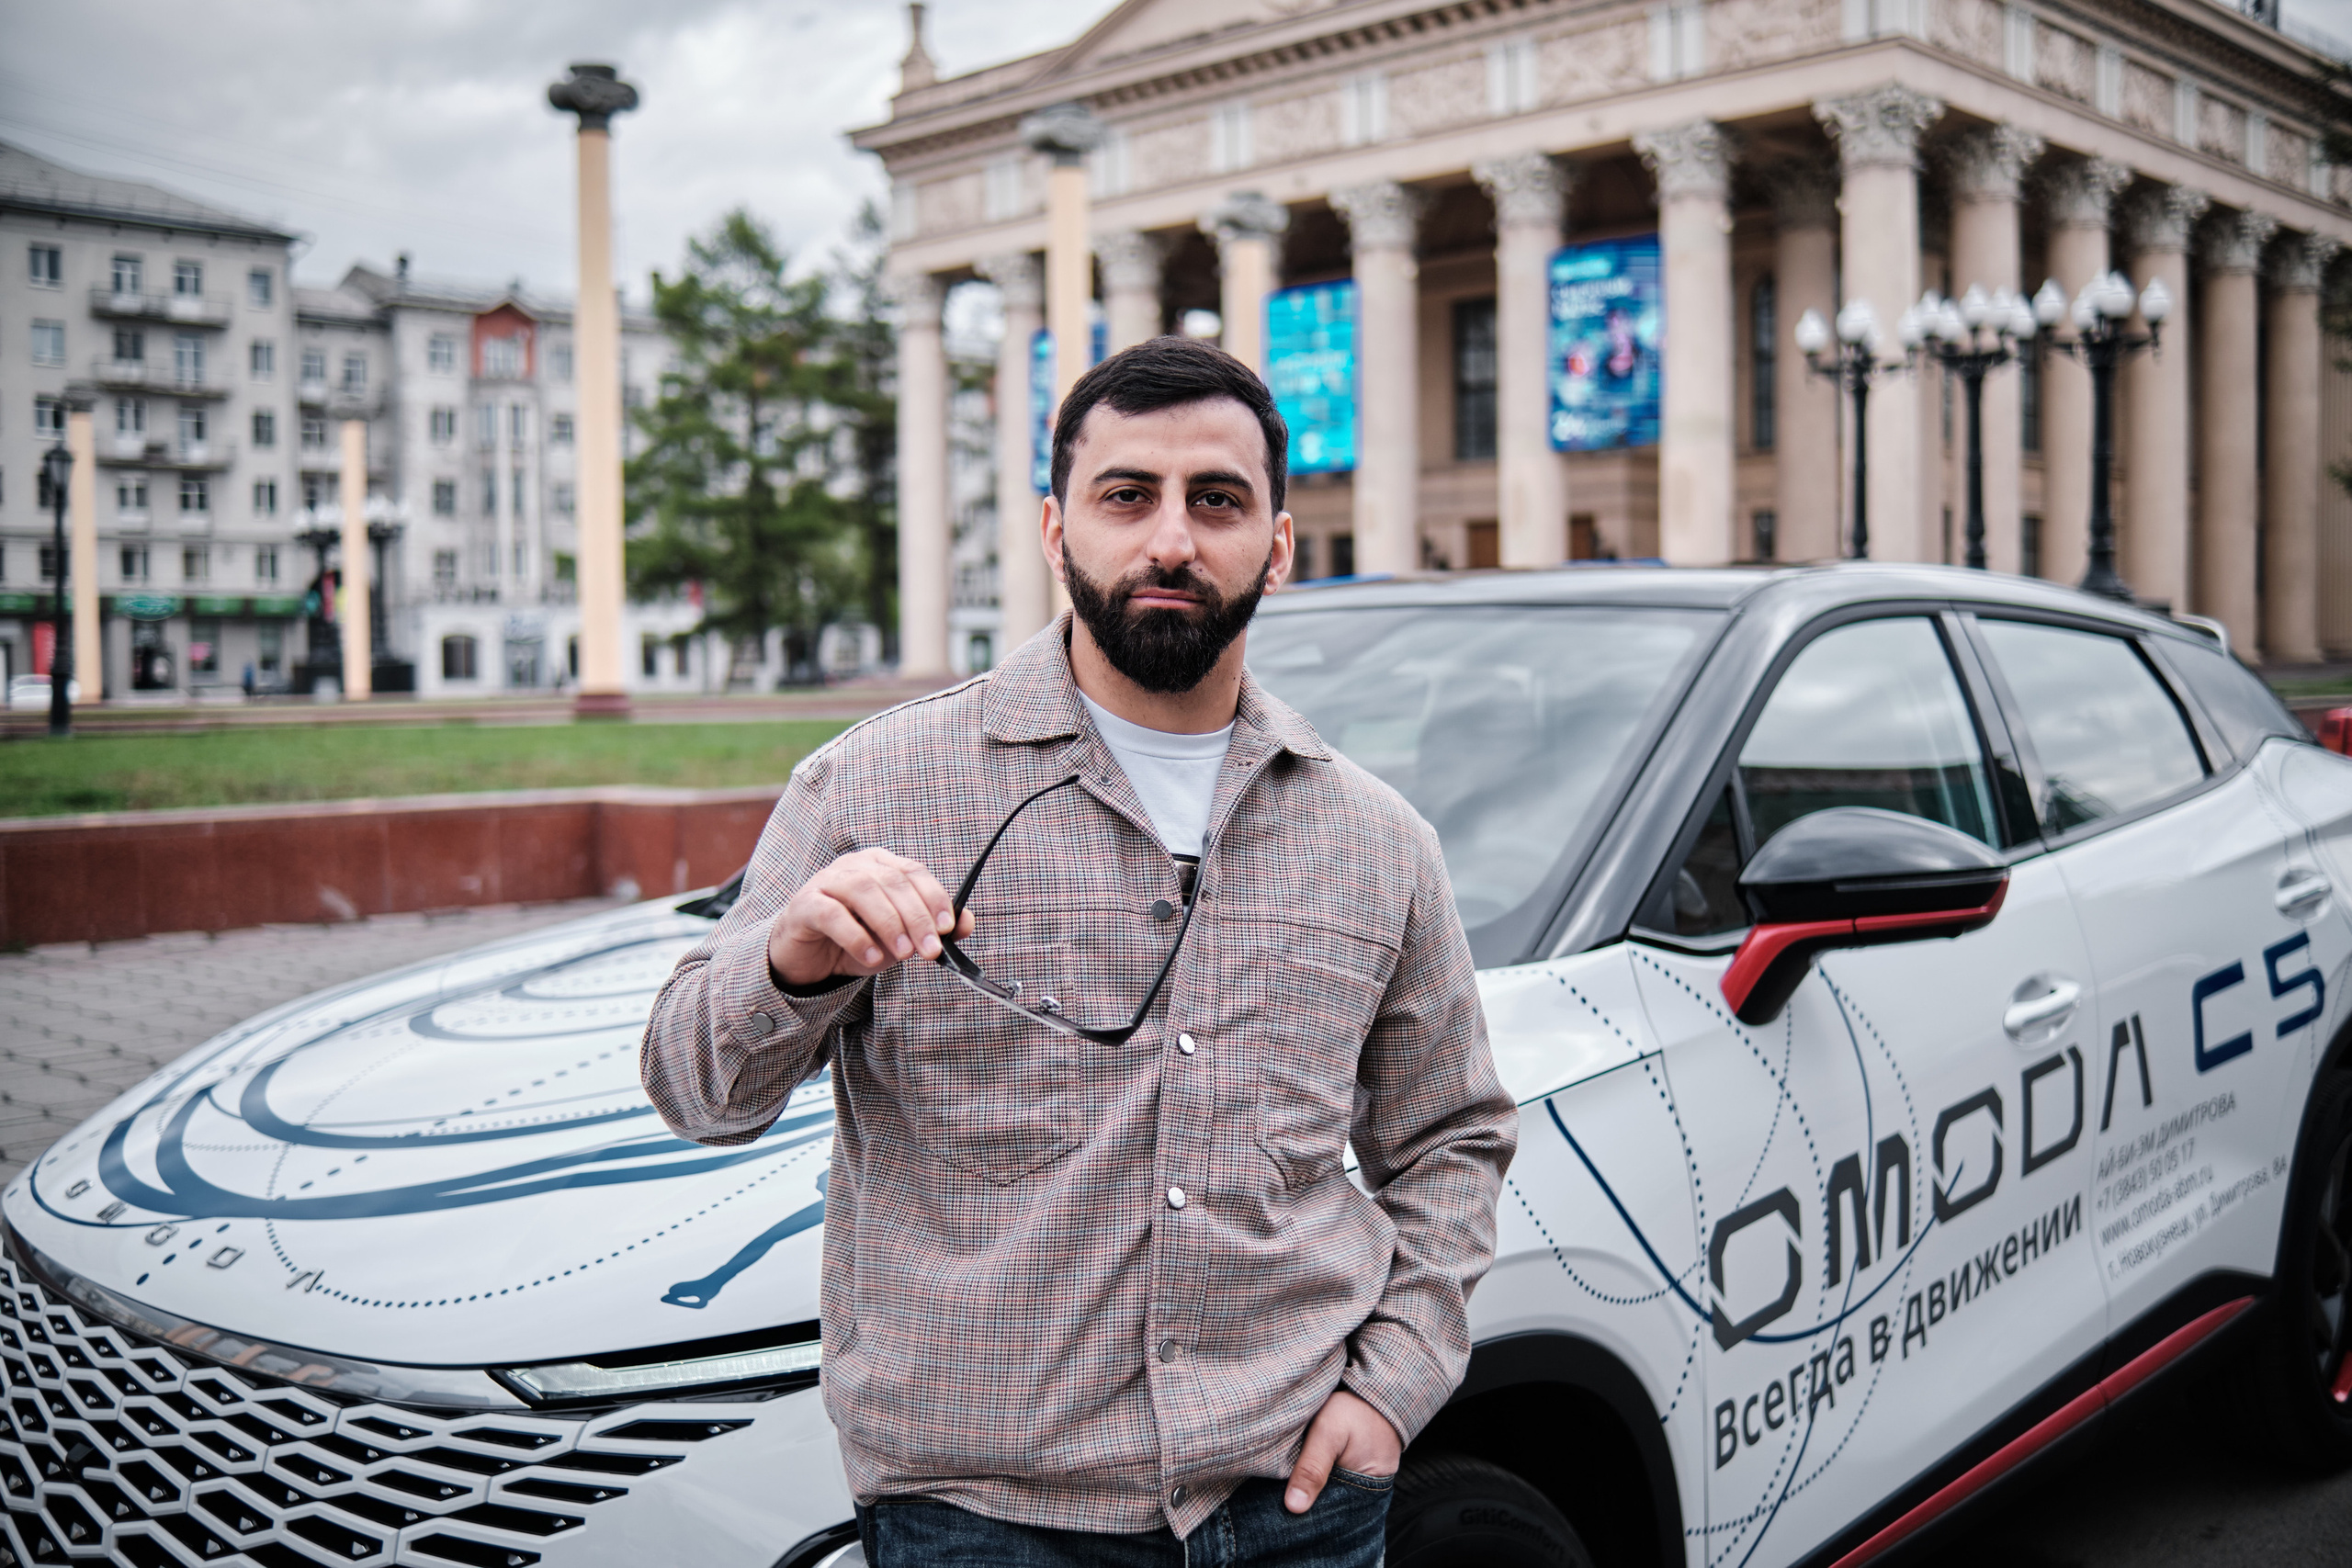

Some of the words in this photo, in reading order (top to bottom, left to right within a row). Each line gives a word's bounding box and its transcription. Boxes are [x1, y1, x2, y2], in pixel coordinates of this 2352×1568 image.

[2191, 931, 2325, 1075] C5
[2096, 1187, 2111, 1213] +7
[2113, 1165, 2147, 1210] (3843)
[2165, 1147, 2178, 1176] 05
[2181, 1136, 2195, 1165] 17
[2097, 1129, 2155, 1183] АЙ-БИ-ЭМ
[2156, 1090, 2236, 1148] ДИМИТРОВА
[1713, 1333, 1855, 1471] Всегда
[1869, 1313, 1891, 1367] в
[1902, 1191, 2082, 1360] движении
